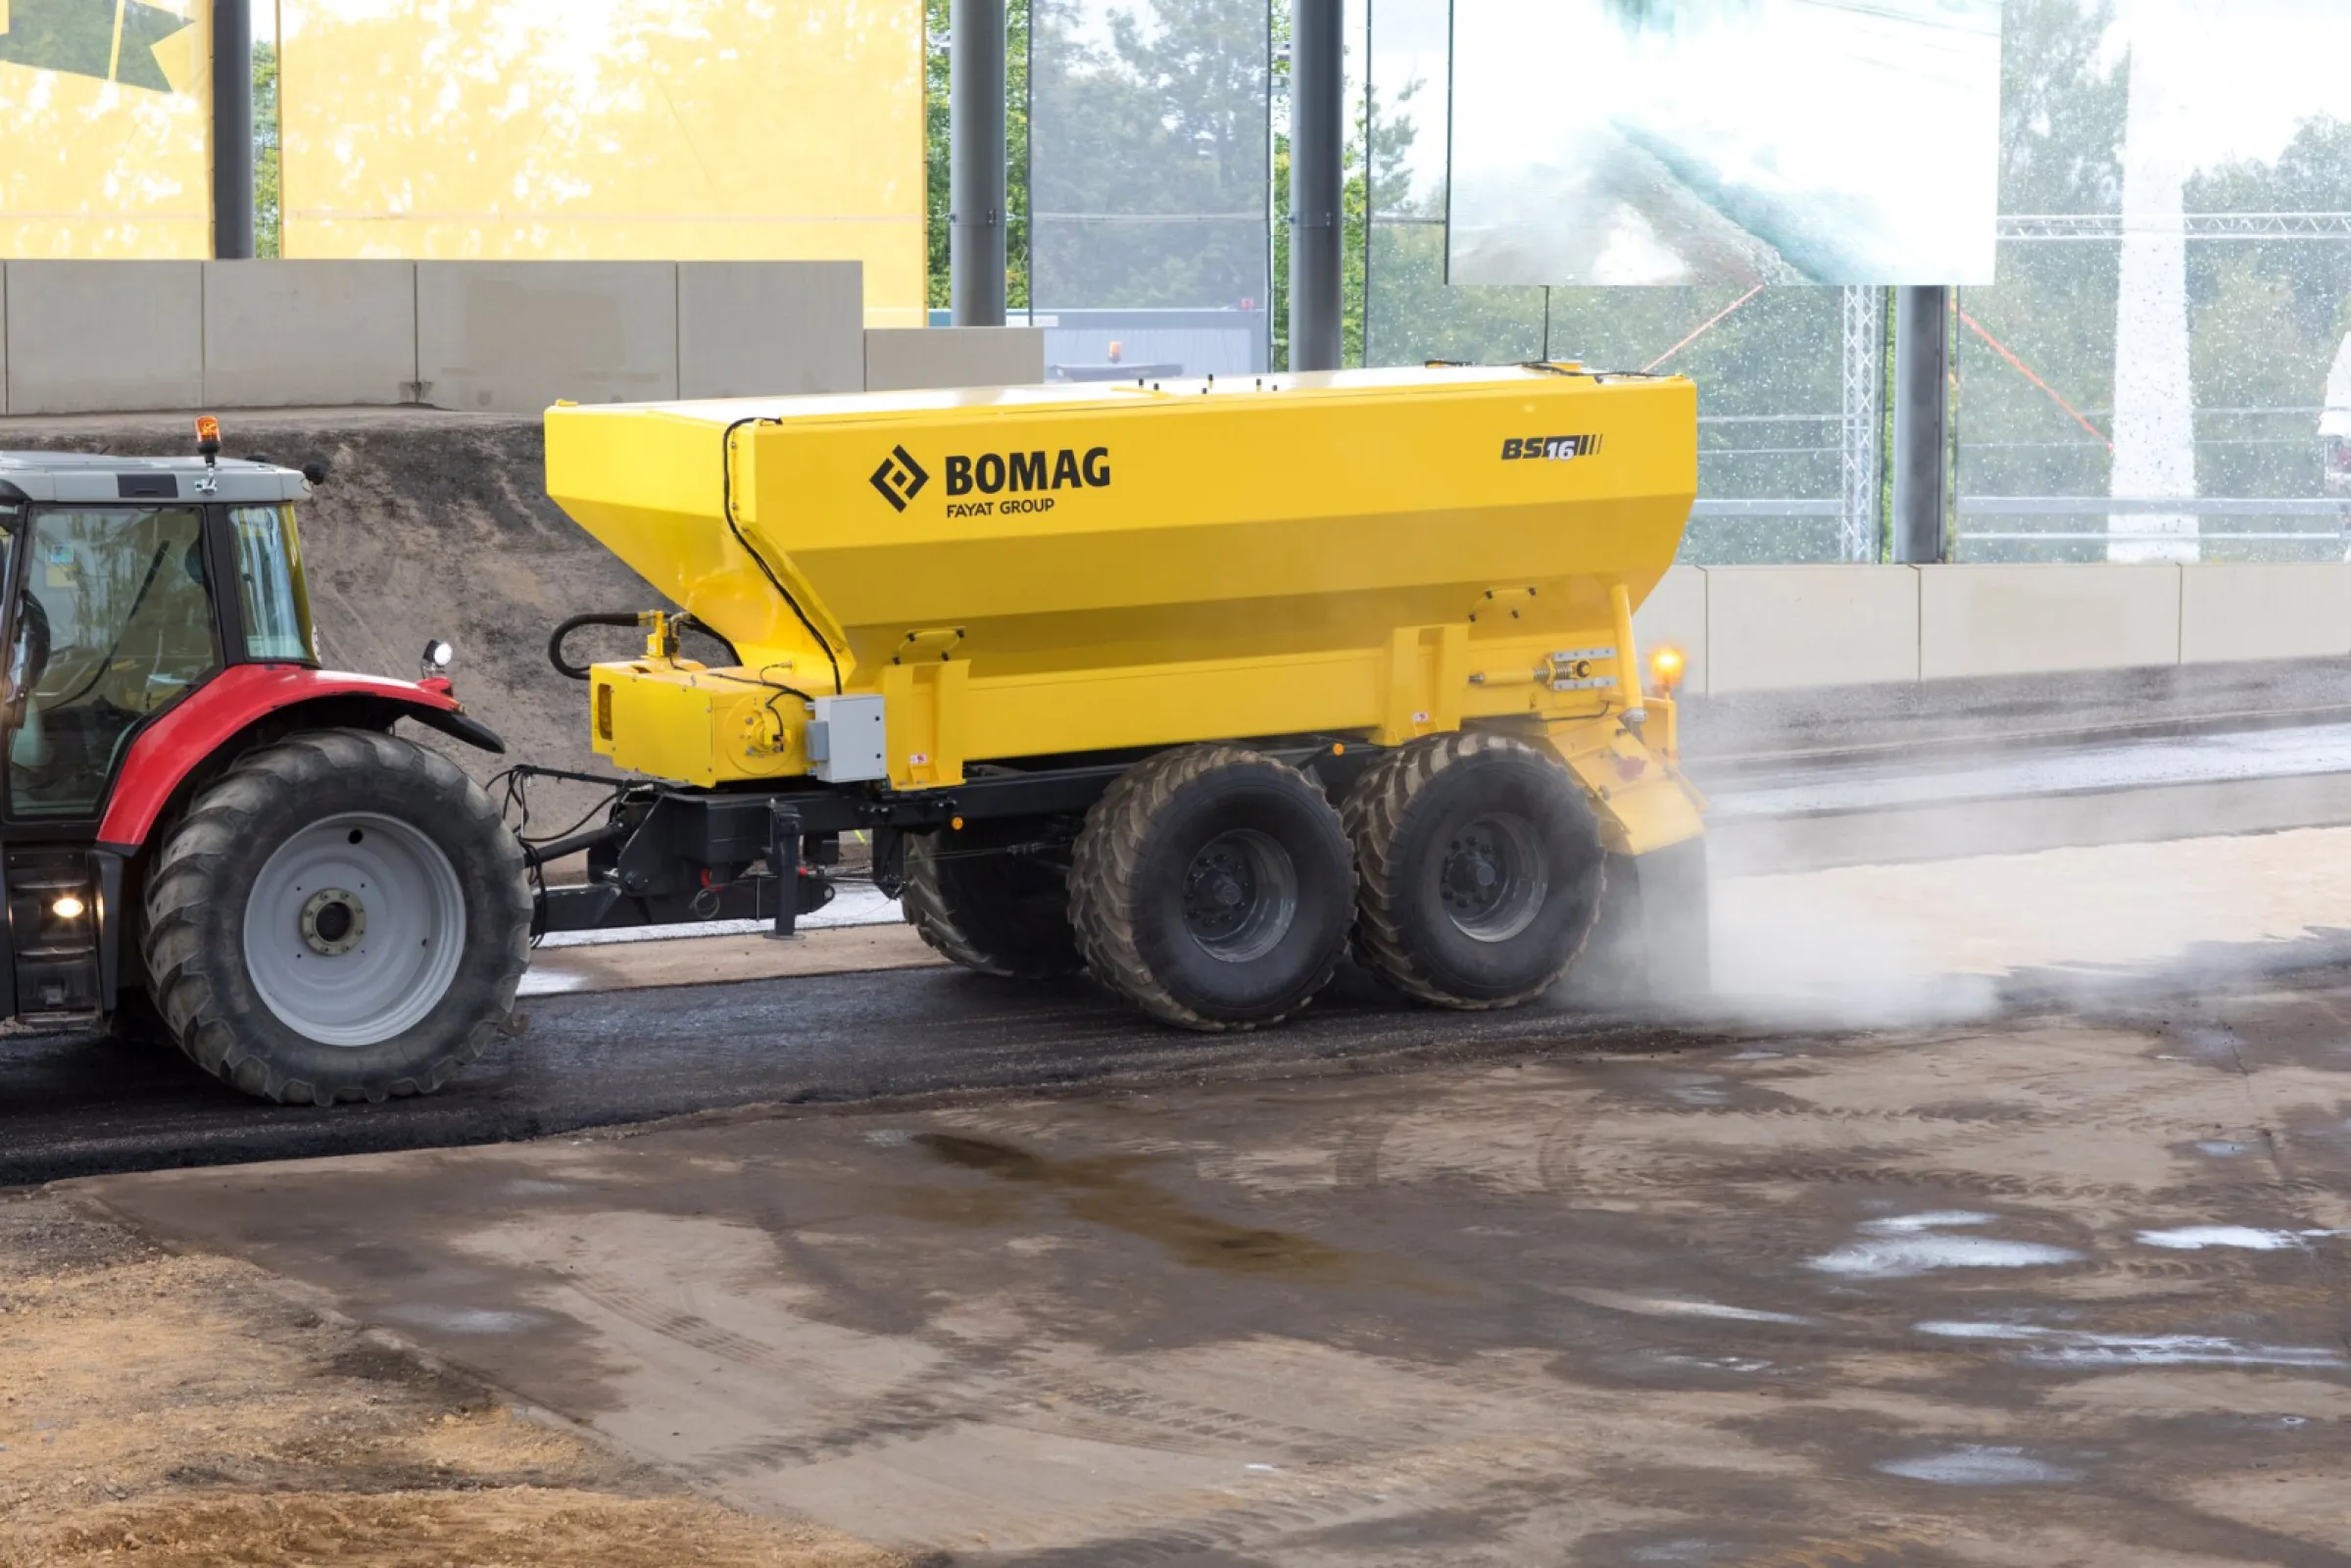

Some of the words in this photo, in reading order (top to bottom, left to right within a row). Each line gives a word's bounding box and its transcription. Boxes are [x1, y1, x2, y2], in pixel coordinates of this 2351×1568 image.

[946, 447, 1110, 496] BOMAG
[947, 502, 994, 518] FAYAT
[1000, 498, 1055, 514] GROUP
